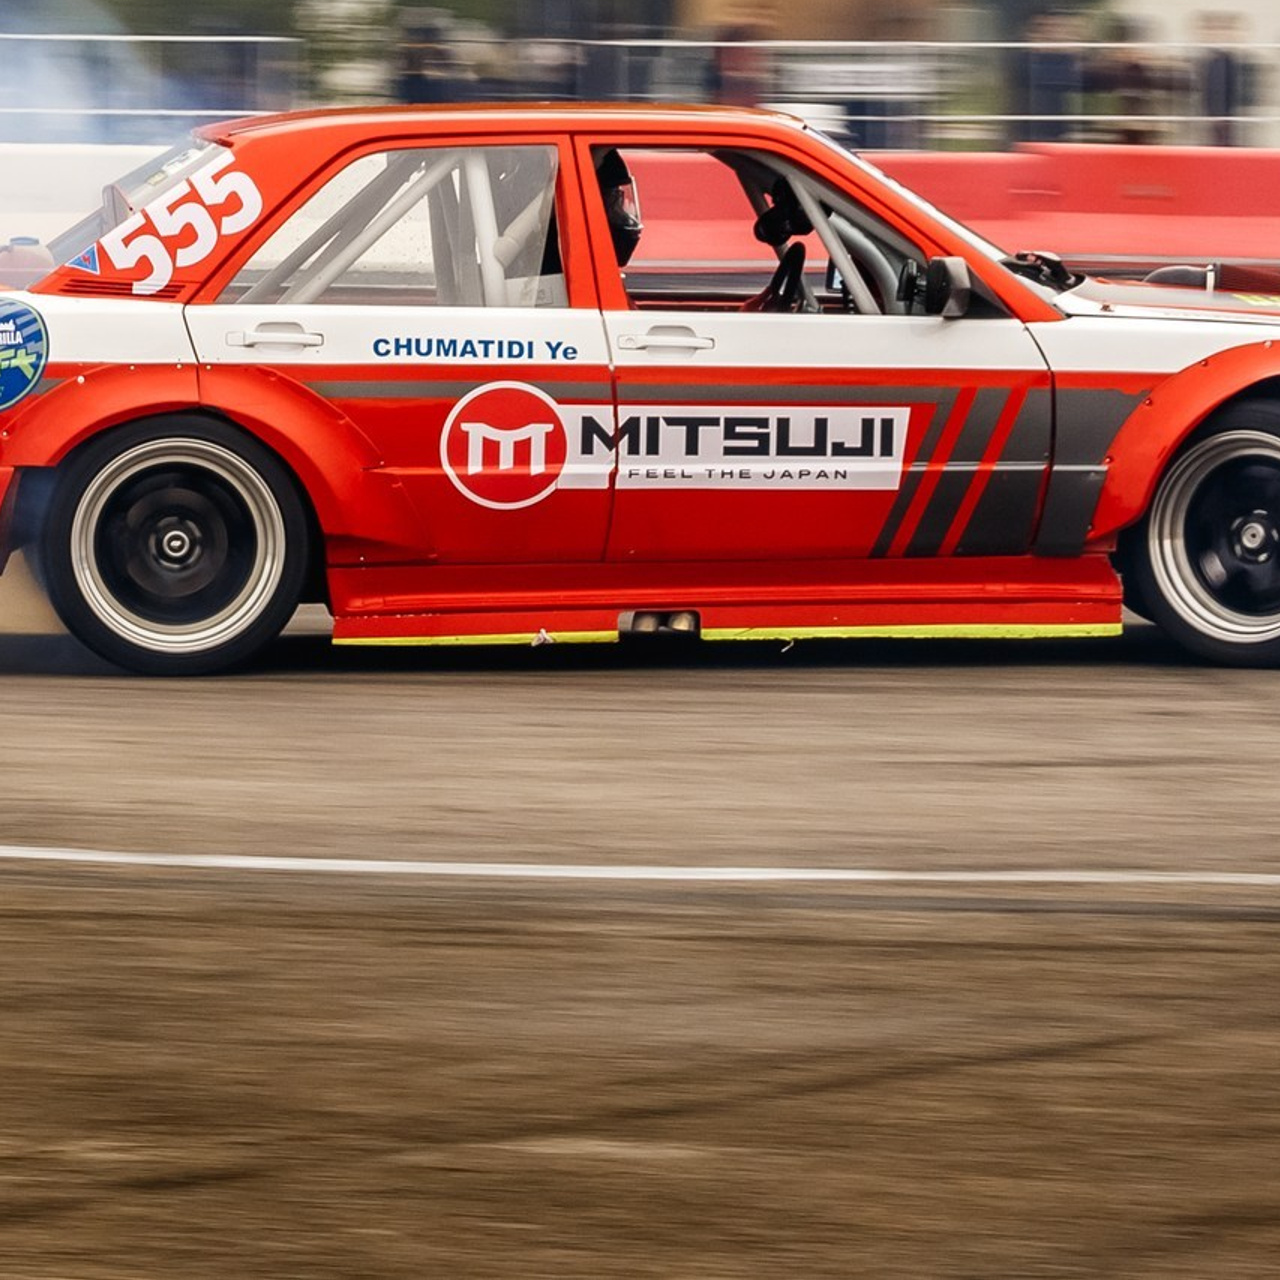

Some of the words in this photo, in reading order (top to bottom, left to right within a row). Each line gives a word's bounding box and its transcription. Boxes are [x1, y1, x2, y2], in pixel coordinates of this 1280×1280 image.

[99, 150, 263, 295] 555
[373, 338, 533, 359] CHUMATIDI
[545, 341, 578, 360] Ye
[581, 416, 894, 457] MITSUJI
[628, 469, 693, 478] FEEL
[705, 469, 751, 479] THE
[763, 469, 847, 480] JAPAN
